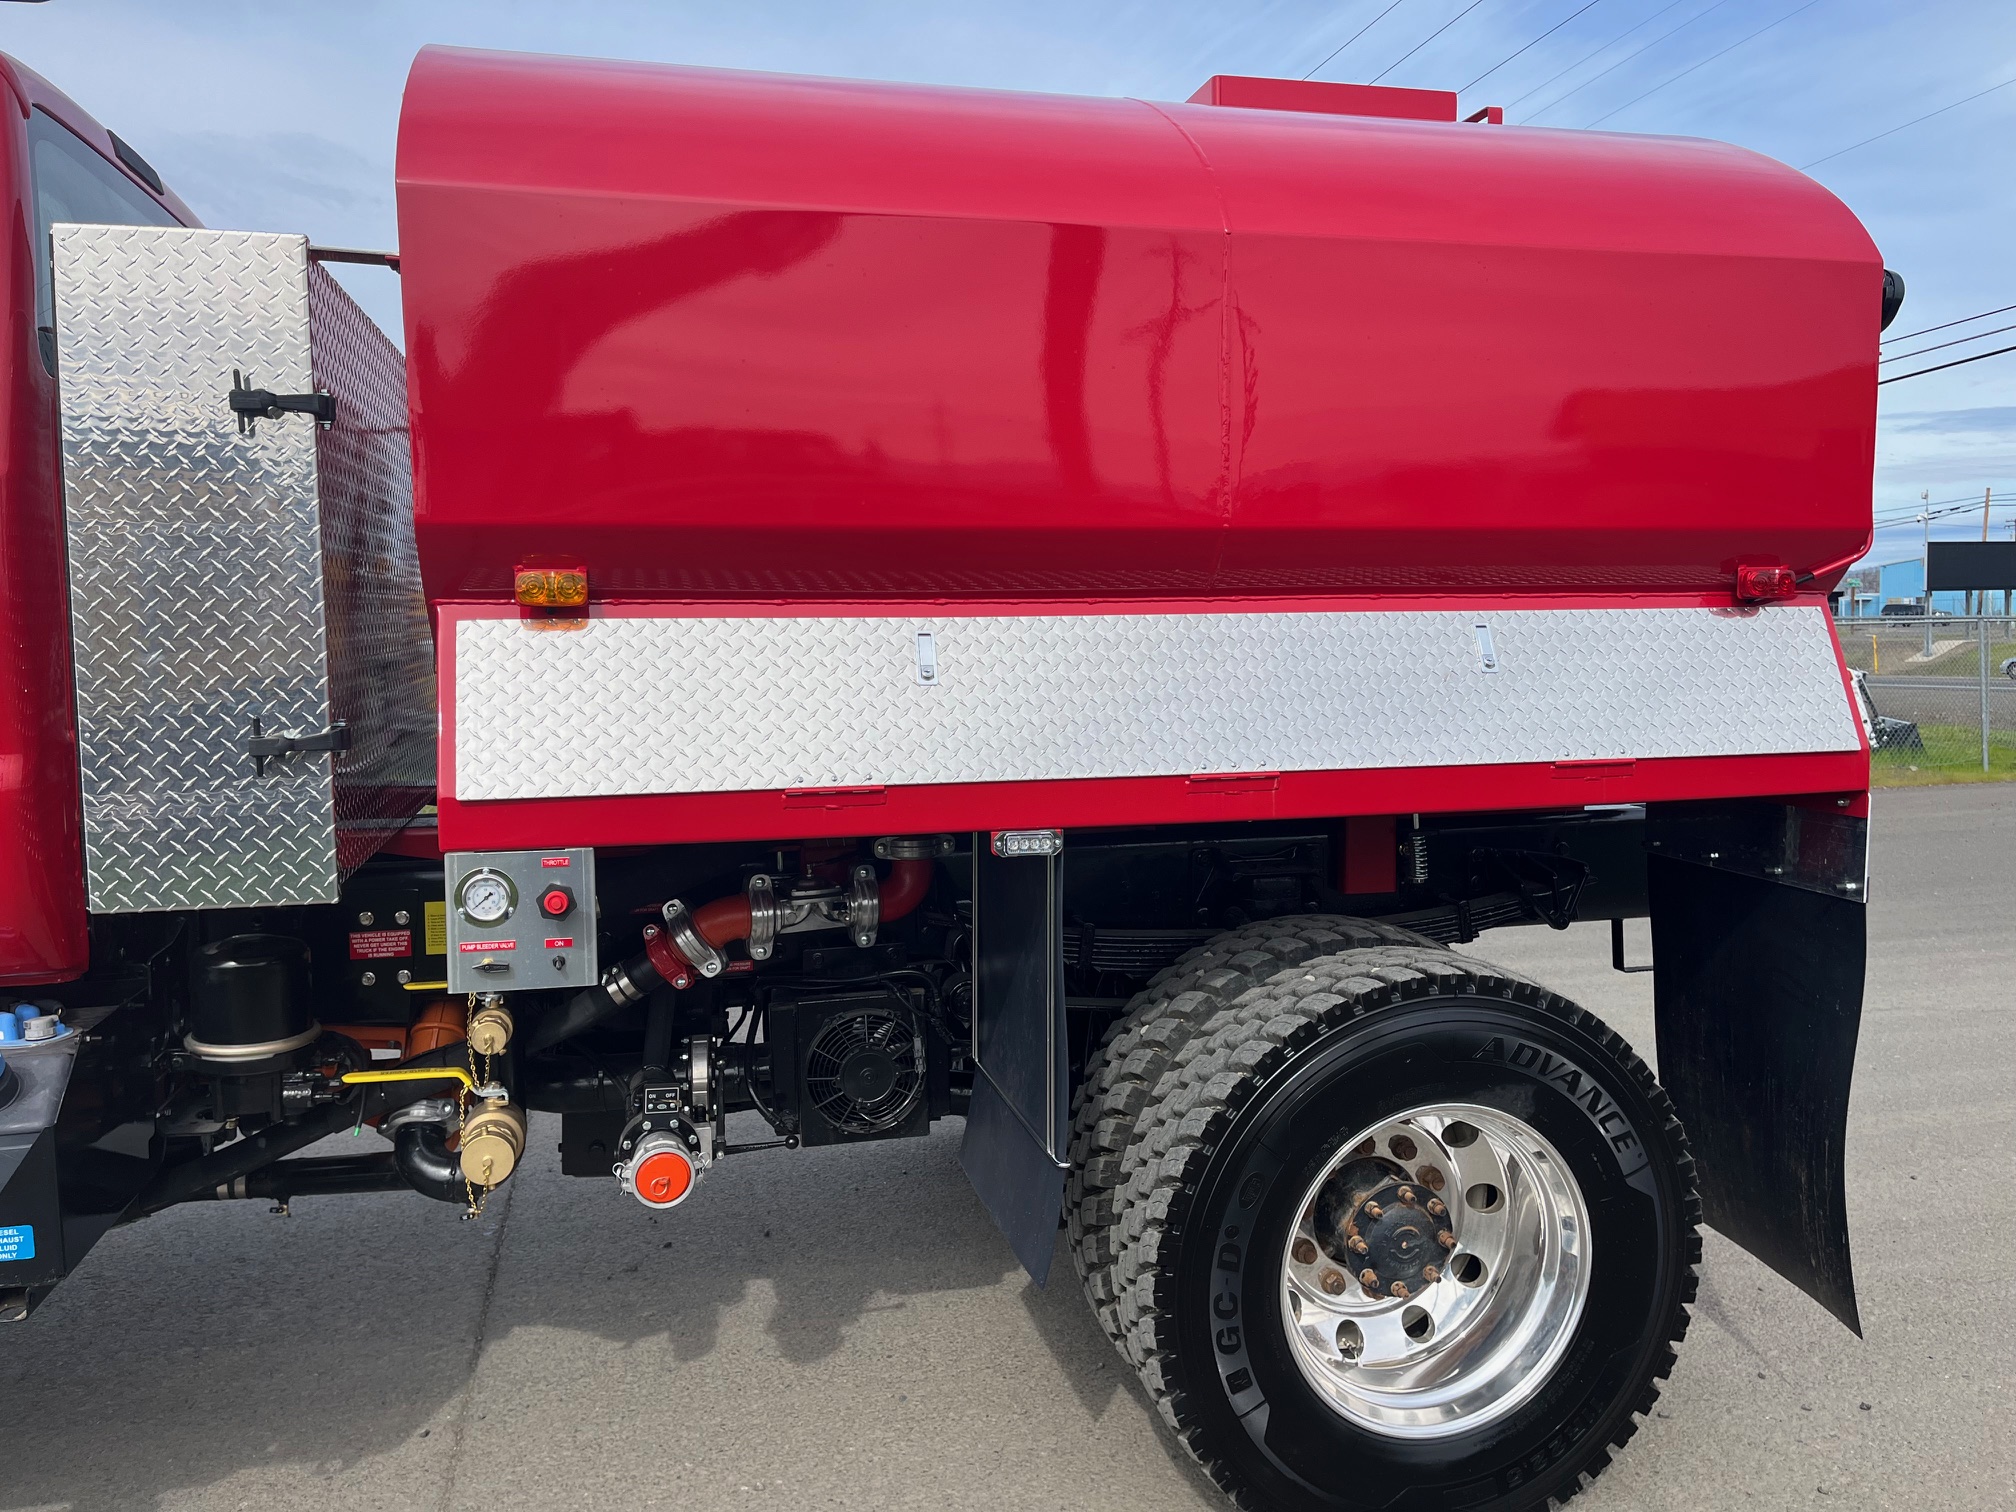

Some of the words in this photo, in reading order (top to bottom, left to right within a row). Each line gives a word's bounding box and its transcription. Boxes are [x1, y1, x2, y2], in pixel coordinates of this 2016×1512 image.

[461, 943, 476, 951] PUMP
[476, 942, 499, 950] BLEEDER
[499, 941, 514, 949] VALVE
[1472, 1036, 1638, 1154] ADVANCE
